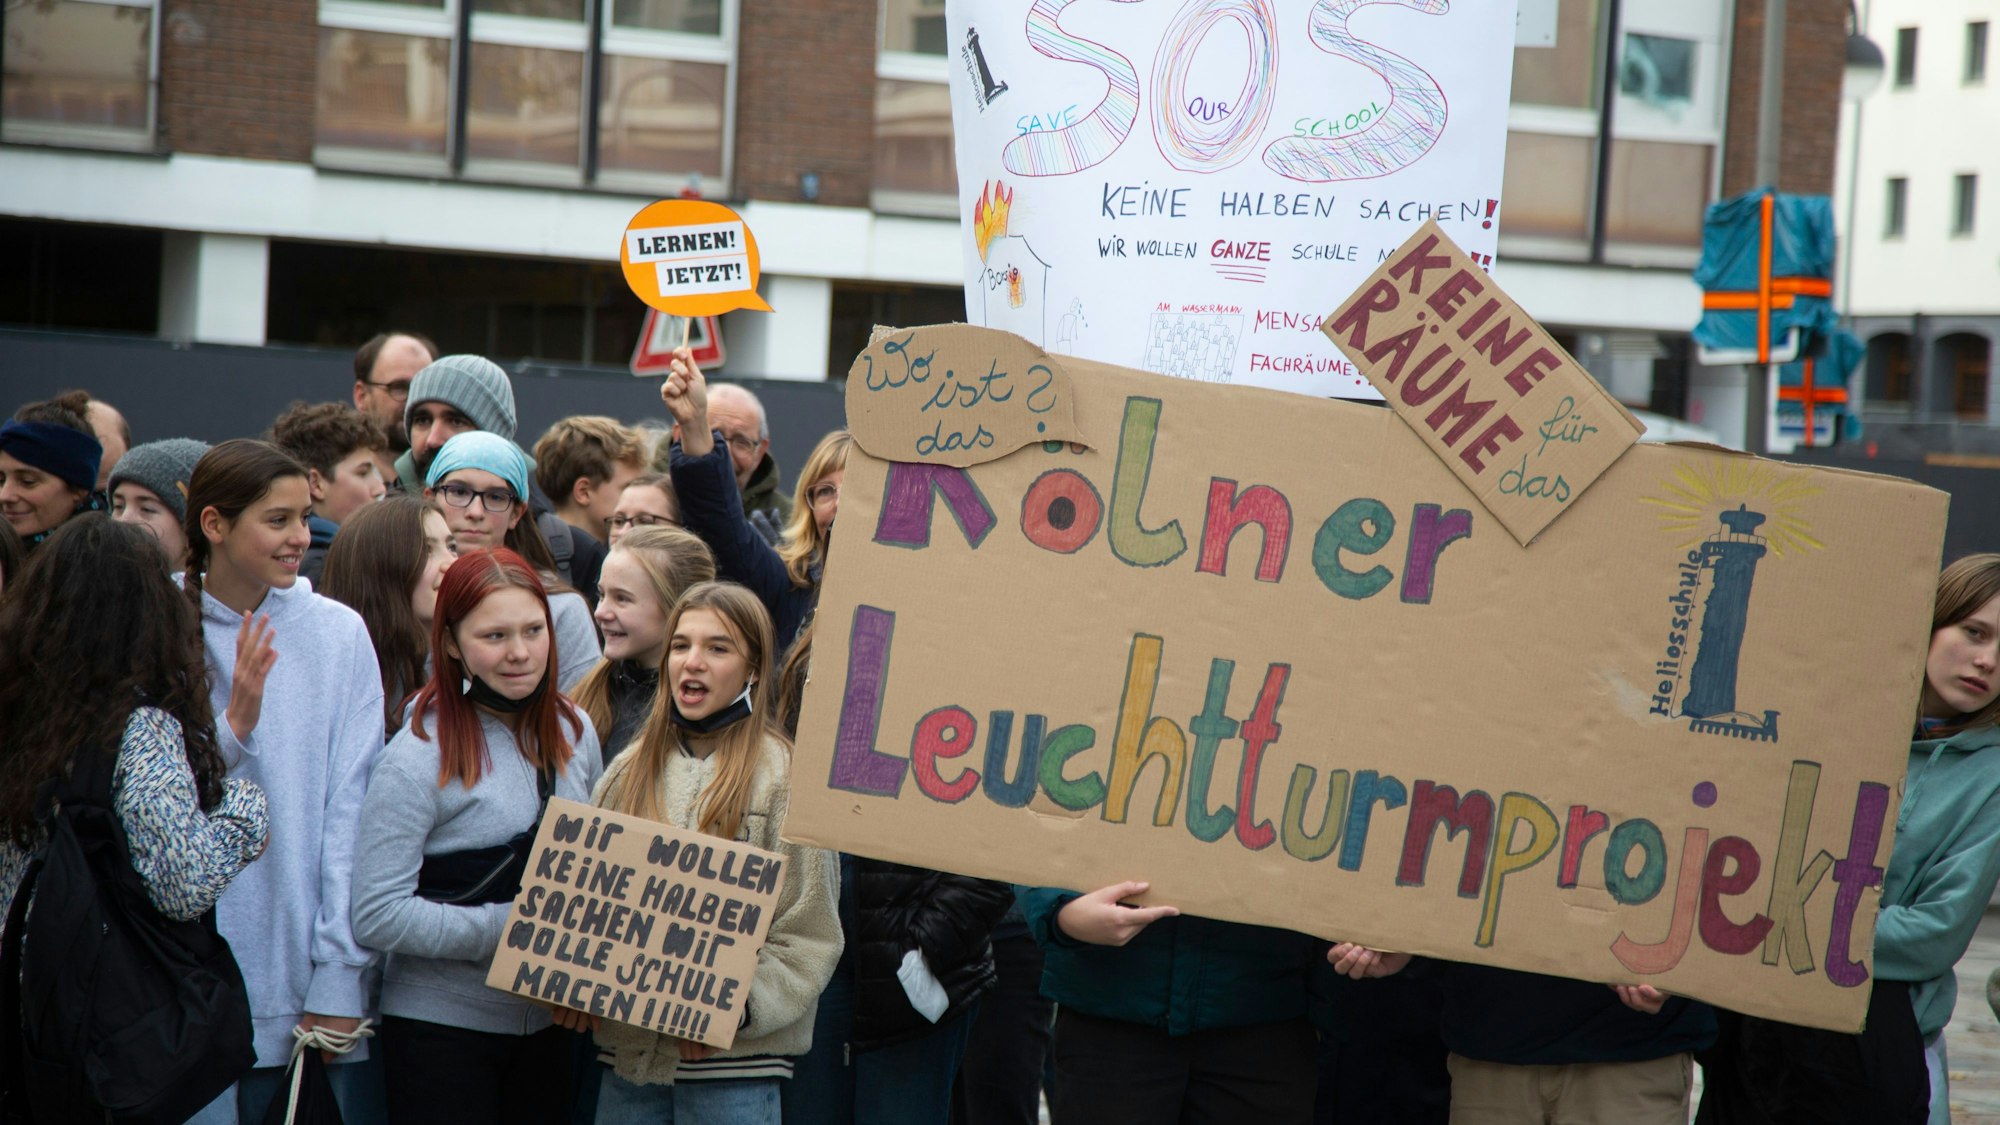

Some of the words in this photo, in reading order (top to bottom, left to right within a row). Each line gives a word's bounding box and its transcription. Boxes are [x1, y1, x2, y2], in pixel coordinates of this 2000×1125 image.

[1002, 0, 1450, 183] SOS
[1016, 104, 1078, 136] SAVE
[1188, 97, 1231, 121] OUR
[1293, 102, 1385, 138] SCHOOL
[1220, 191, 1335, 218] HALBEN
[1360, 198, 1499, 230] SACHEN!
[637, 230, 736, 256] LERNEN!
[1136, 240, 1198, 259] WOLLEN
[1210, 239, 1271, 262] GANZE
[1291, 243, 1359, 262] SCHULE
[666, 262, 742, 286] JETZT!
[1156, 302, 1171, 312] AM
[1254, 309, 1323, 333] MENSA
[1388, 233, 1562, 397] KEINE
[863, 332, 940, 392] Wo
[921, 357, 1014, 413] ist
[1331, 278, 1524, 475] RÄUME
[915, 419, 995, 456] das
[1538, 396, 1599, 457] für
[1499, 453, 1571, 503] das
[1649, 549, 1703, 717] Heliosschule
[827, 604, 1890, 988] Leuchtturmprojekt
[647, 834, 782, 895] WOLLEN
[518, 885, 655, 949] SACHEN
[639, 875, 762, 937] HALBEN
[616, 953, 739, 1012] SCHULE
